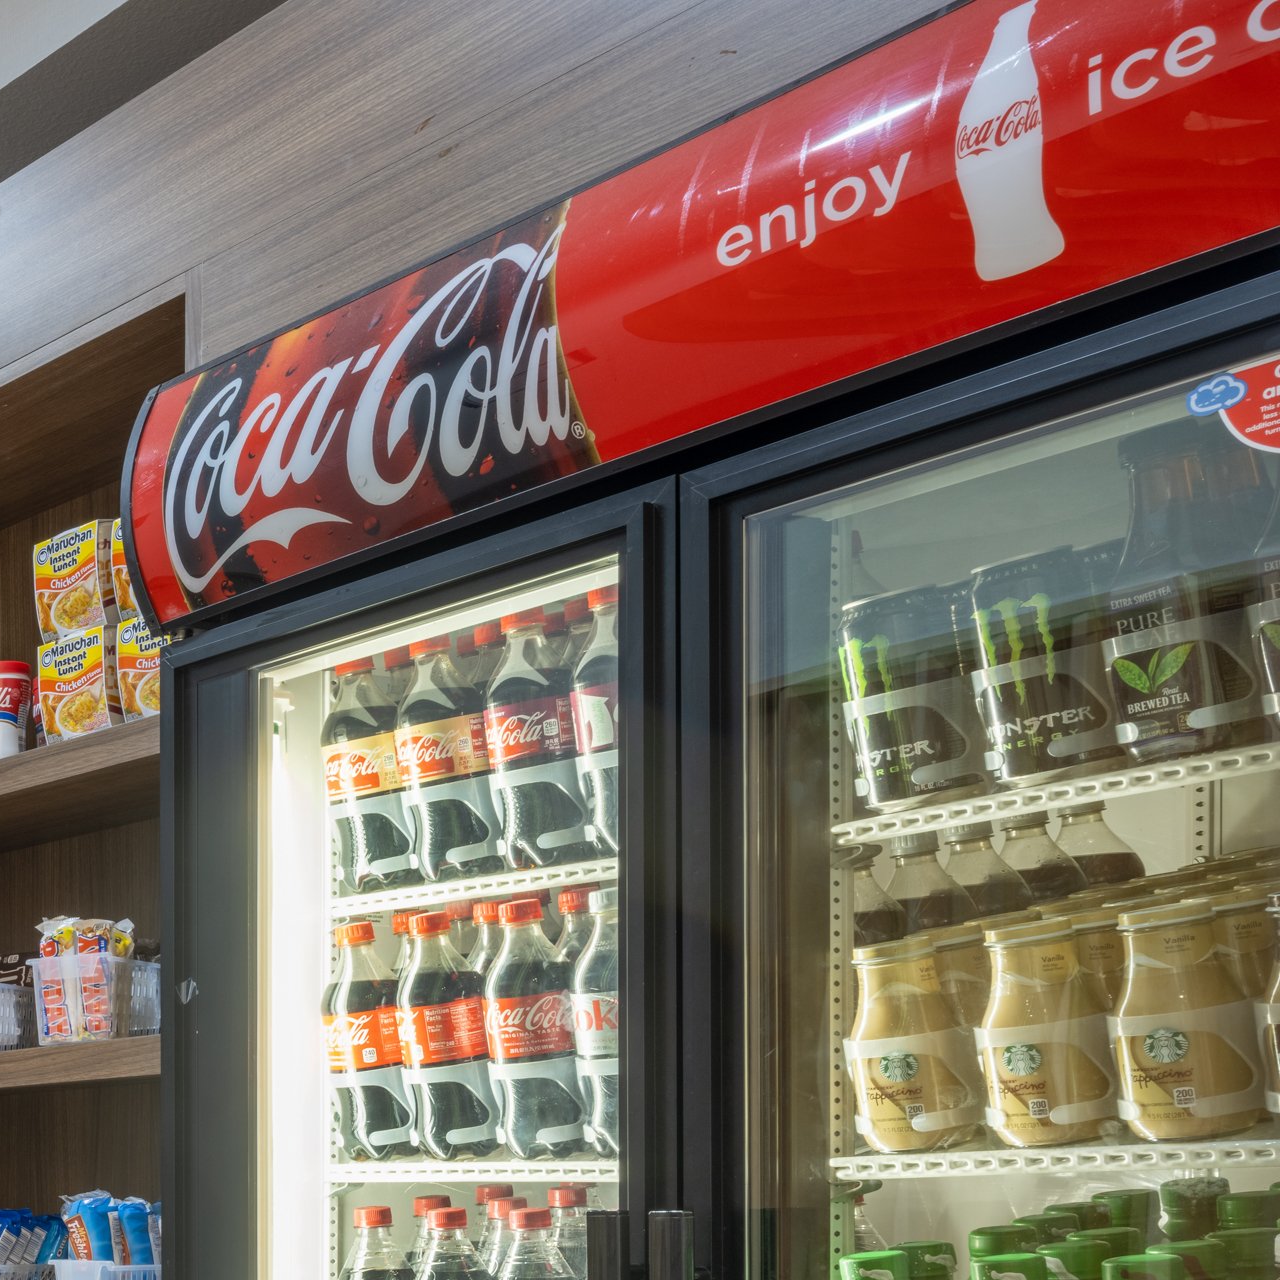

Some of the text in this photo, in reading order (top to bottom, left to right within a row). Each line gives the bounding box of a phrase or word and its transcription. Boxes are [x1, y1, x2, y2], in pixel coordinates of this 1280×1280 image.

[1086, 25, 1216, 116] ice
[955, 96, 1040, 159] Coca-Cola
[716, 152, 912, 268] enjoy
[163, 226, 571, 593] Coca-Cola
[46, 528, 93, 554] Maruchan
[49, 547, 81, 566] Instant
[53, 559, 78, 573] Lunch
[50, 561, 96, 589] Chicken Flavor
[1111, 585, 1172, 610] EXTRA SWEET TEA
[1116, 606, 1176, 636] PURE
[51, 633, 99, 658] Maruchan
[140, 636, 169, 653] Lunch
[54, 652, 87, 669] Instant
[136, 657, 160, 669] Chick
[58, 662, 84, 677] Lunch
[55, 667, 102, 692] Chicken Flavor
[1162, 686, 1180, 695] Real
[1128, 695, 1169, 714] BREWED
[1170, 692, 1190, 703] TEA
[544, 720, 557, 729] 260
[1163, 934, 1195, 945] Vanilla
[1041, 954, 1065, 965] Vanilla
[425, 1008, 449, 1016] Nutrition
[1175, 1088, 1194, 1098] 200
[908, 1105, 924, 1114] 200
[1031, 1100, 1047, 1109] 200
